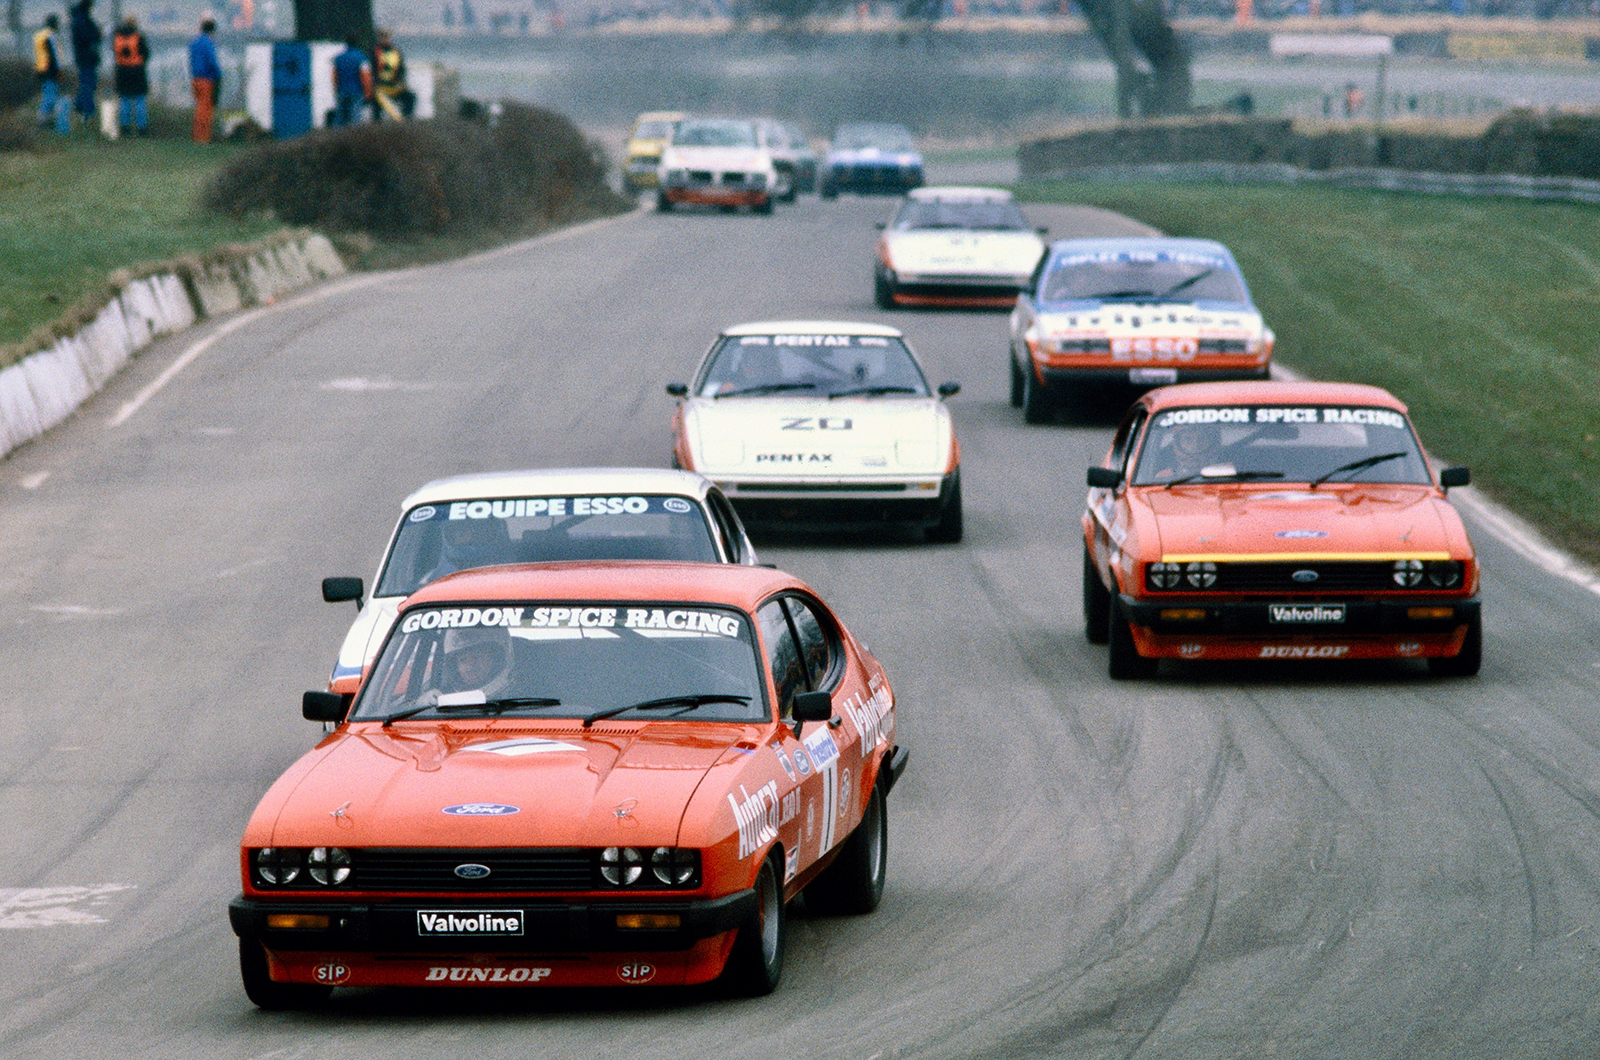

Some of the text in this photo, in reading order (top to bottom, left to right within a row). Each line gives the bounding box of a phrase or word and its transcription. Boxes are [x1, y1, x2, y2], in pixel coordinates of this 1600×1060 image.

[773, 335, 850, 347] PENTAX
[1111, 339, 1199, 361] ESSO
[1256, 408, 1318, 423] SPICE
[1324, 409, 1404, 429] RACING
[756, 453, 833, 463] PENTAX
[448, 496, 649, 521] EQUIPE ESSO
[402, 607, 740, 638] GORDON SPICE RACING
[1273, 608, 1342, 622] Valvoline
[1258, 645, 1350, 659] DUNLOP
[455, 803, 505, 814] Ford
[462, 865, 482, 876] Ford
[421, 914, 519, 933] Valvoline
[317, 963, 345, 981] STP
[425, 967, 552, 983] DUNLOP
